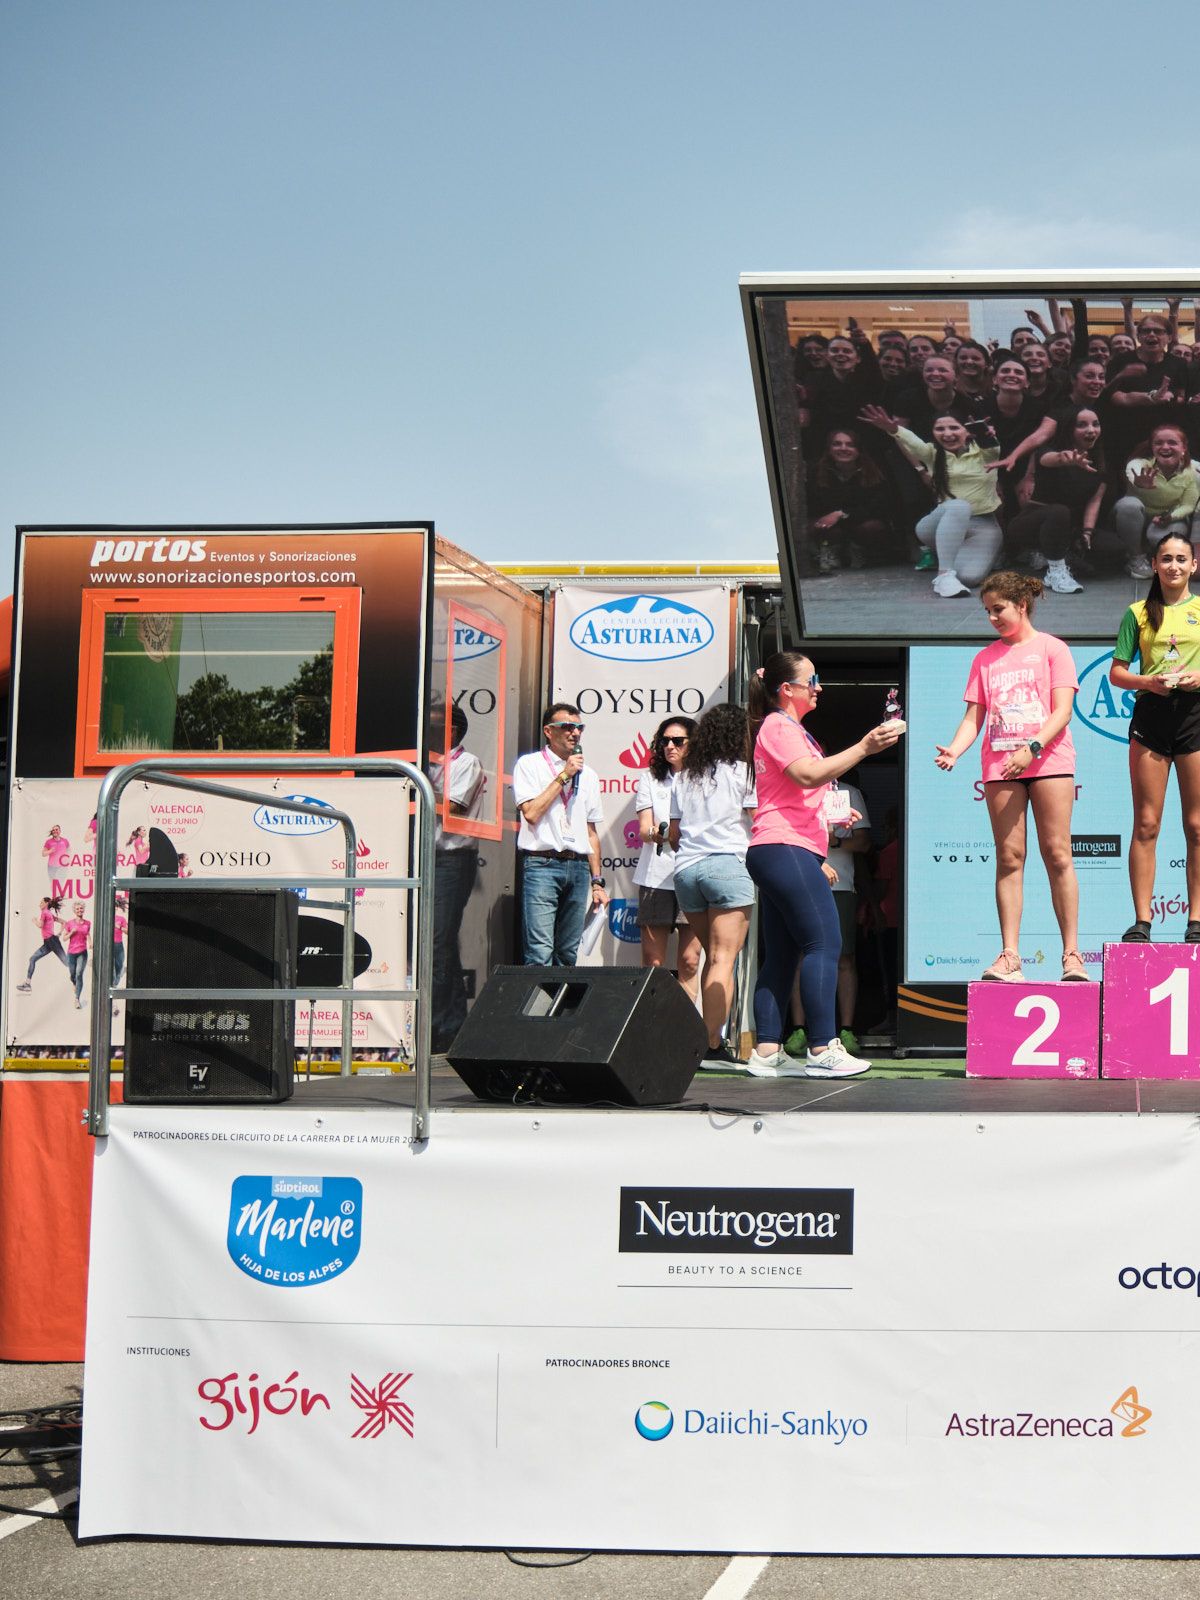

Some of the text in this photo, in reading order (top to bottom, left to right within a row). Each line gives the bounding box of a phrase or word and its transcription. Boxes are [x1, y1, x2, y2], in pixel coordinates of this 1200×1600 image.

[90, 537, 357, 567] portos Eventos y Sonorizaciones
[90, 570, 356, 585] www.sonorizacionesportos.com
[580, 620, 703, 645] ASTURIANA
[576, 688, 705, 715] OYSHO
[150, 805, 204, 814] VALENCIA
[1071, 841, 1117, 855] utrogena
[59, 854, 137, 867] CARRA
[200, 852, 271, 867] OYSHO
[332, 860, 389, 870] Saander
[932, 855, 990, 863] VOLV
[936, 956, 980, 966] Daiichi-Sankyo
[351, 1011, 373, 1021] OSA
[1149, 968, 1189, 1056] 1
[153, 1011, 250, 1032] portos
[1012, 995, 1061, 1066] 2
[133, 1131, 209, 1141] PATROCINADORES
[212, 1132, 228, 1141] DEL
[230, 1132, 271, 1142] CIRCUITO
[273, 1133, 285, 1142] DE
[287, 1134, 298, 1142] LA
[300, 1134, 341, 1143] CARRERA
[343, 1134, 355, 1143] DE
[357, 1135, 368, 1143] LA
[370, 1135, 400, 1144] MUJER
[236, 1199, 354, 1257] Marlene
[635, 1200, 838, 1247] Neutrogena
[239, 1253, 343, 1283] HIJA DE LOS ALPES
[668, 1265, 803, 1276] BEAUTY TO A SCIENCE
[126, 1347, 191, 1357] INSTITUCIONES
[545, 1359, 670, 1369] PATROCINADORES BRONCE
[198, 1370, 331, 1435] gijón
[684, 1409, 868, 1446] Daiichi-Sankyo
[945, 1412, 1113, 1437] AstraZeneca
